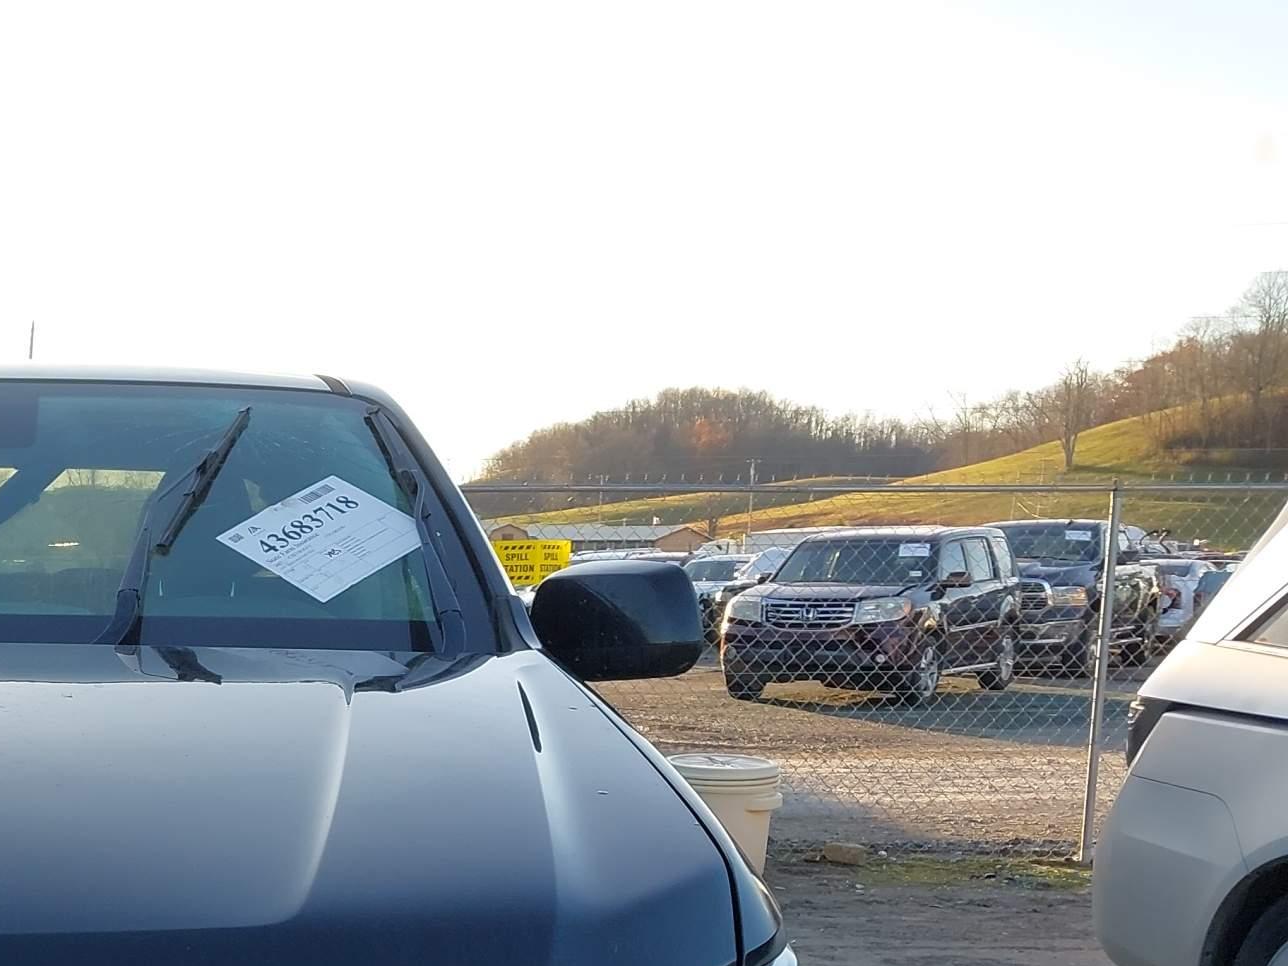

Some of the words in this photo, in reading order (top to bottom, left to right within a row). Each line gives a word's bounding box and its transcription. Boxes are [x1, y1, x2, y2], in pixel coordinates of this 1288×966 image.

[260, 495, 359, 554] 43683718
[505, 553, 529, 561] SPILL
[544, 552, 558, 561] SPILL
[504, 564, 535, 573] TATION
